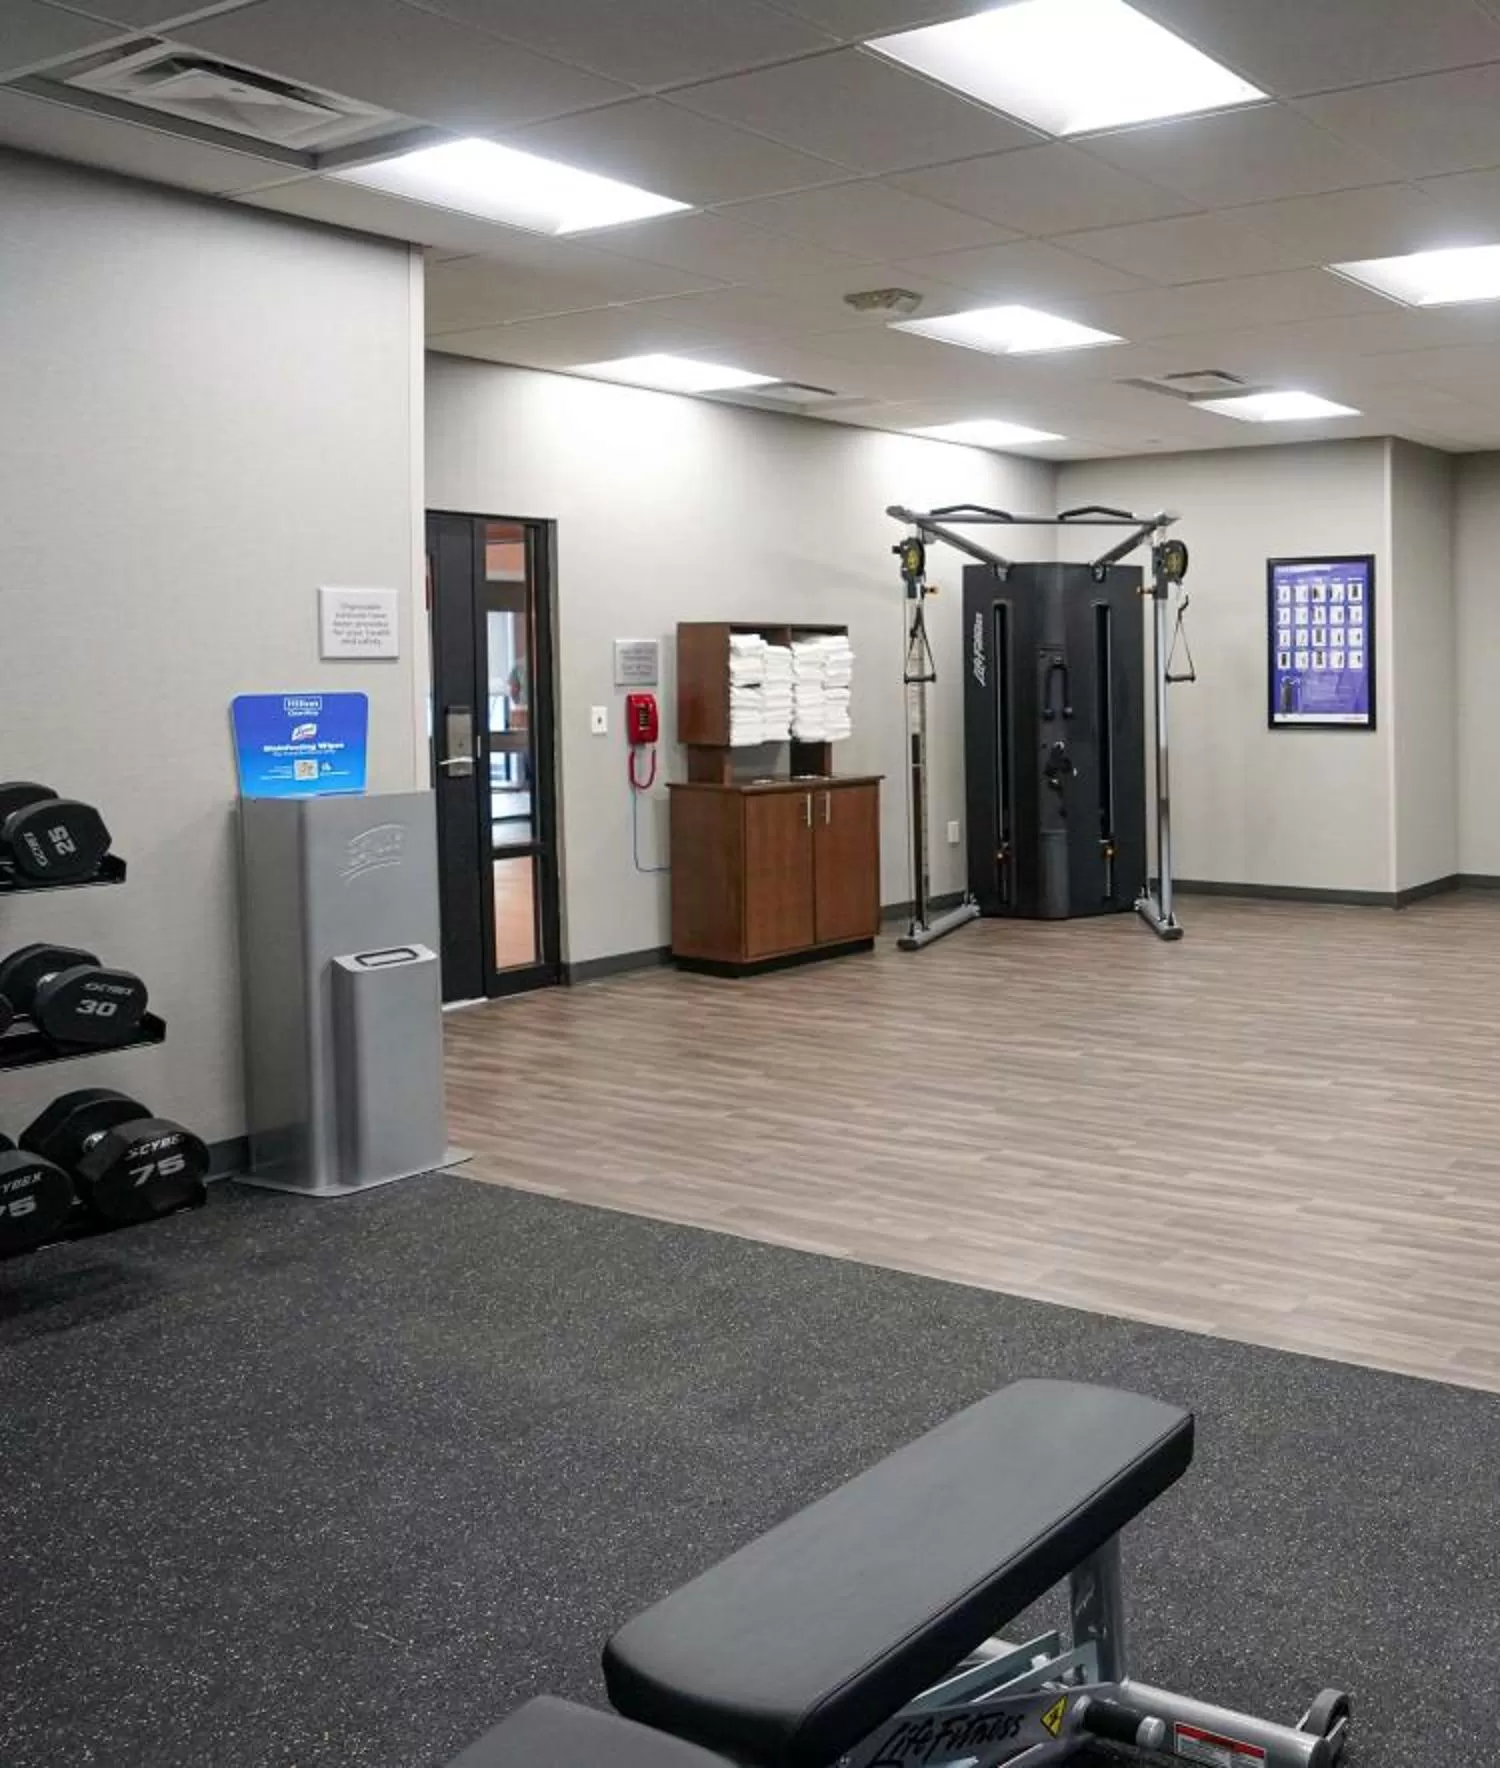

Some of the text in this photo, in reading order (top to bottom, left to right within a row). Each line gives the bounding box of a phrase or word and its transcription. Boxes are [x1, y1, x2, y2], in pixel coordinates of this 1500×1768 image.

[48, 826, 76, 856] 25
[75, 999, 118, 1017] 30
[128, 1153, 187, 1188] 75
